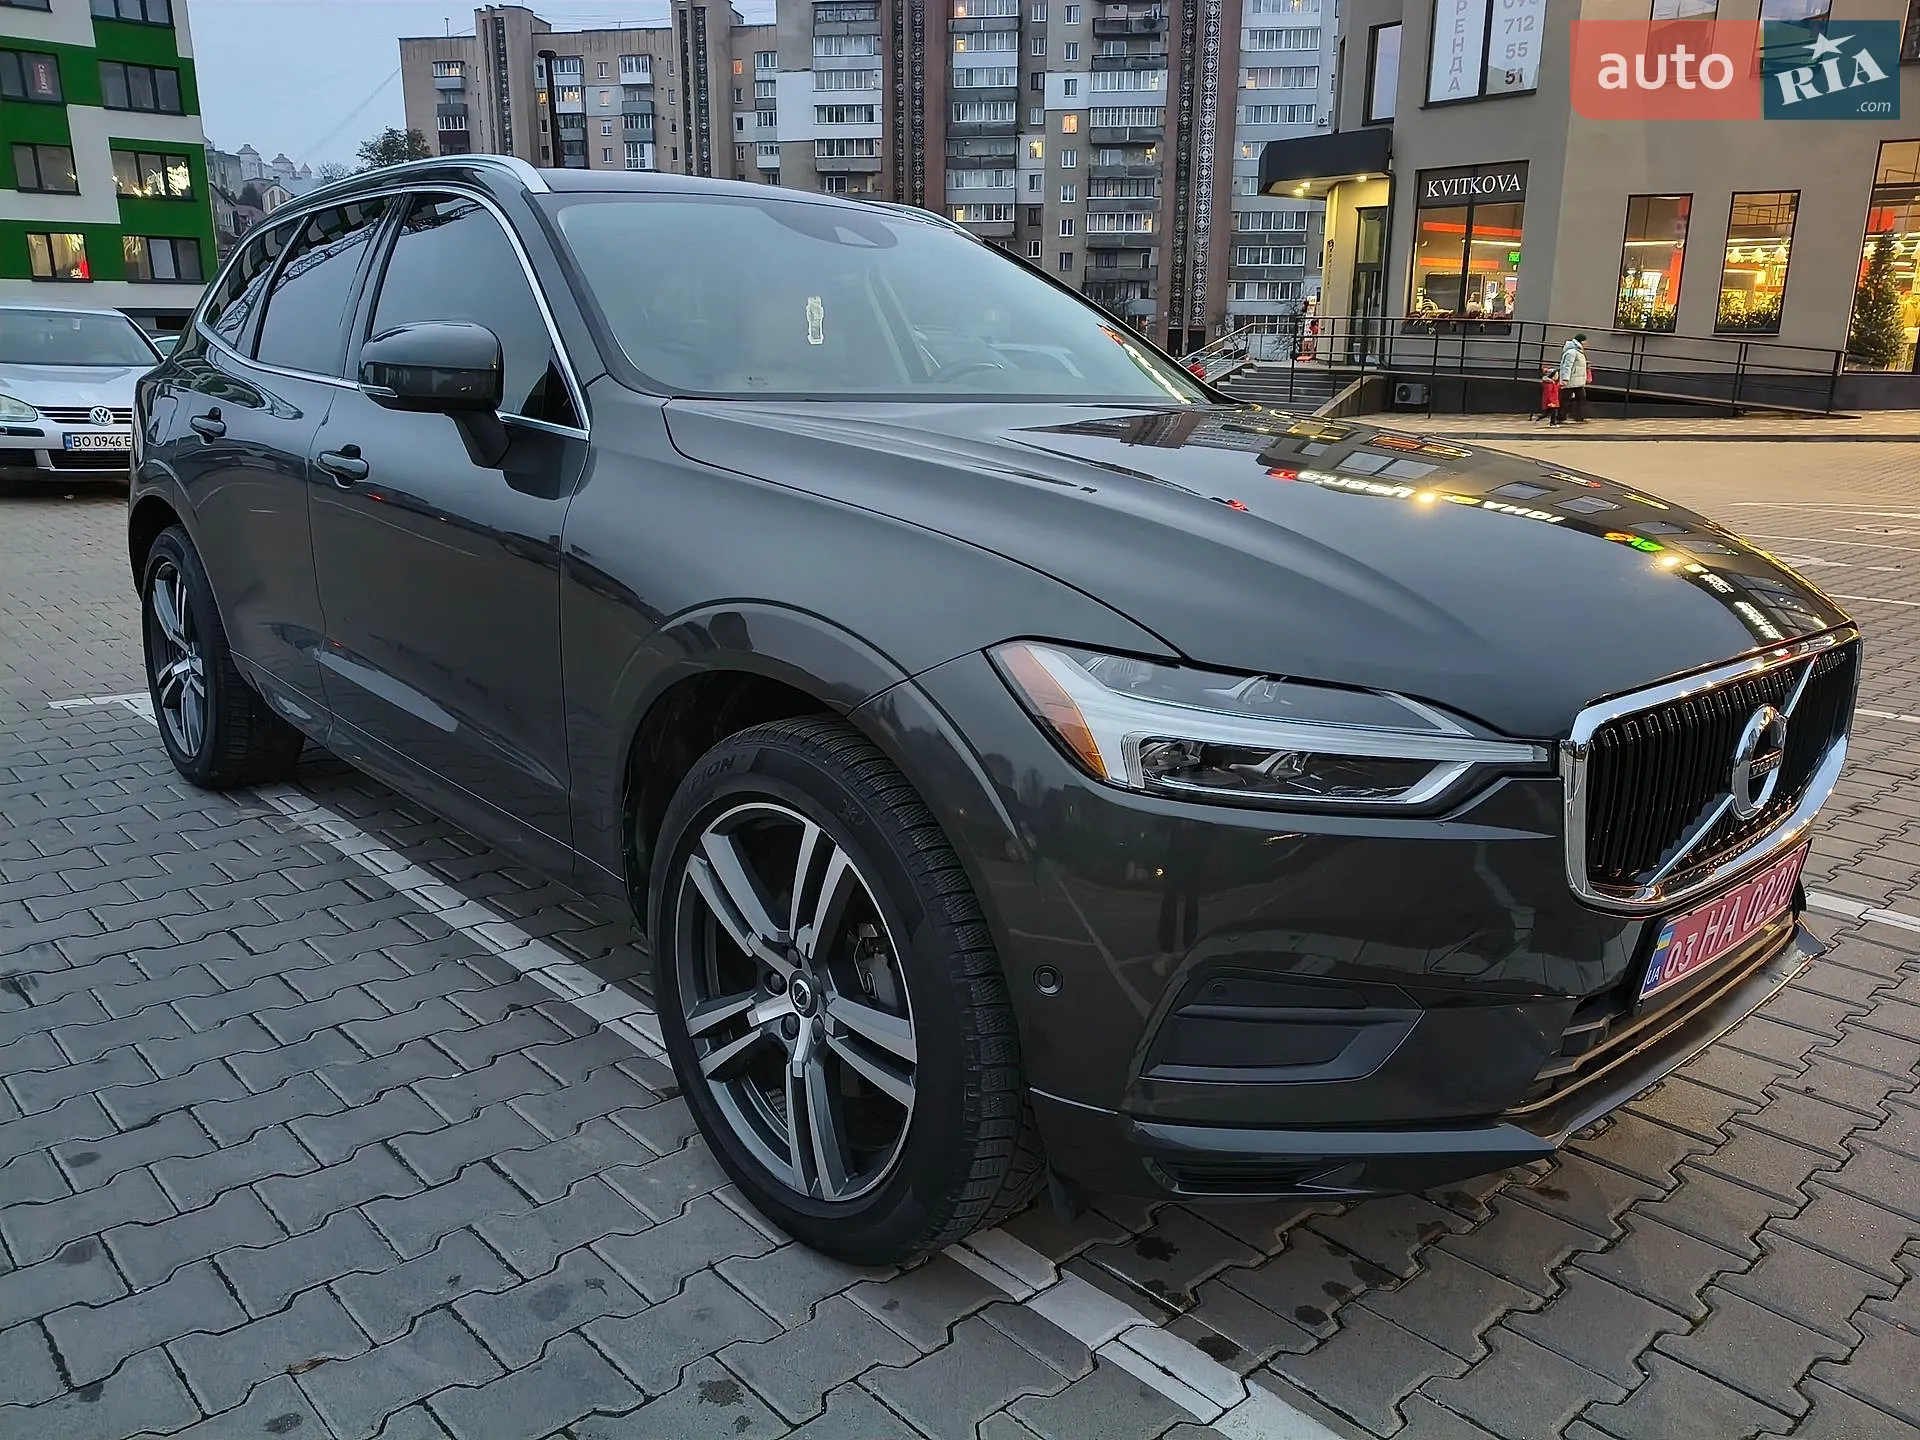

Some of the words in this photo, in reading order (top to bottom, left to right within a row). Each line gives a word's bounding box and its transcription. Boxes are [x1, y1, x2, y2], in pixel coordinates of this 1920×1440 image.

[1504, 15, 1534, 34] 712
[1505, 42, 1528, 59] 55
[1504, 68, 1524, 85] 51
[1426, 173, 1521, 198] KVITKOVA
[73, 436, 91, 447] BO
[94, 436, 121, 447] 0946
[1646, 965, 1661, 986] UA
[1663, 932, 1698, 979] 03
[1697, 896, 1742, 960] HA
[1742, 859, 1798, 932] 0220
